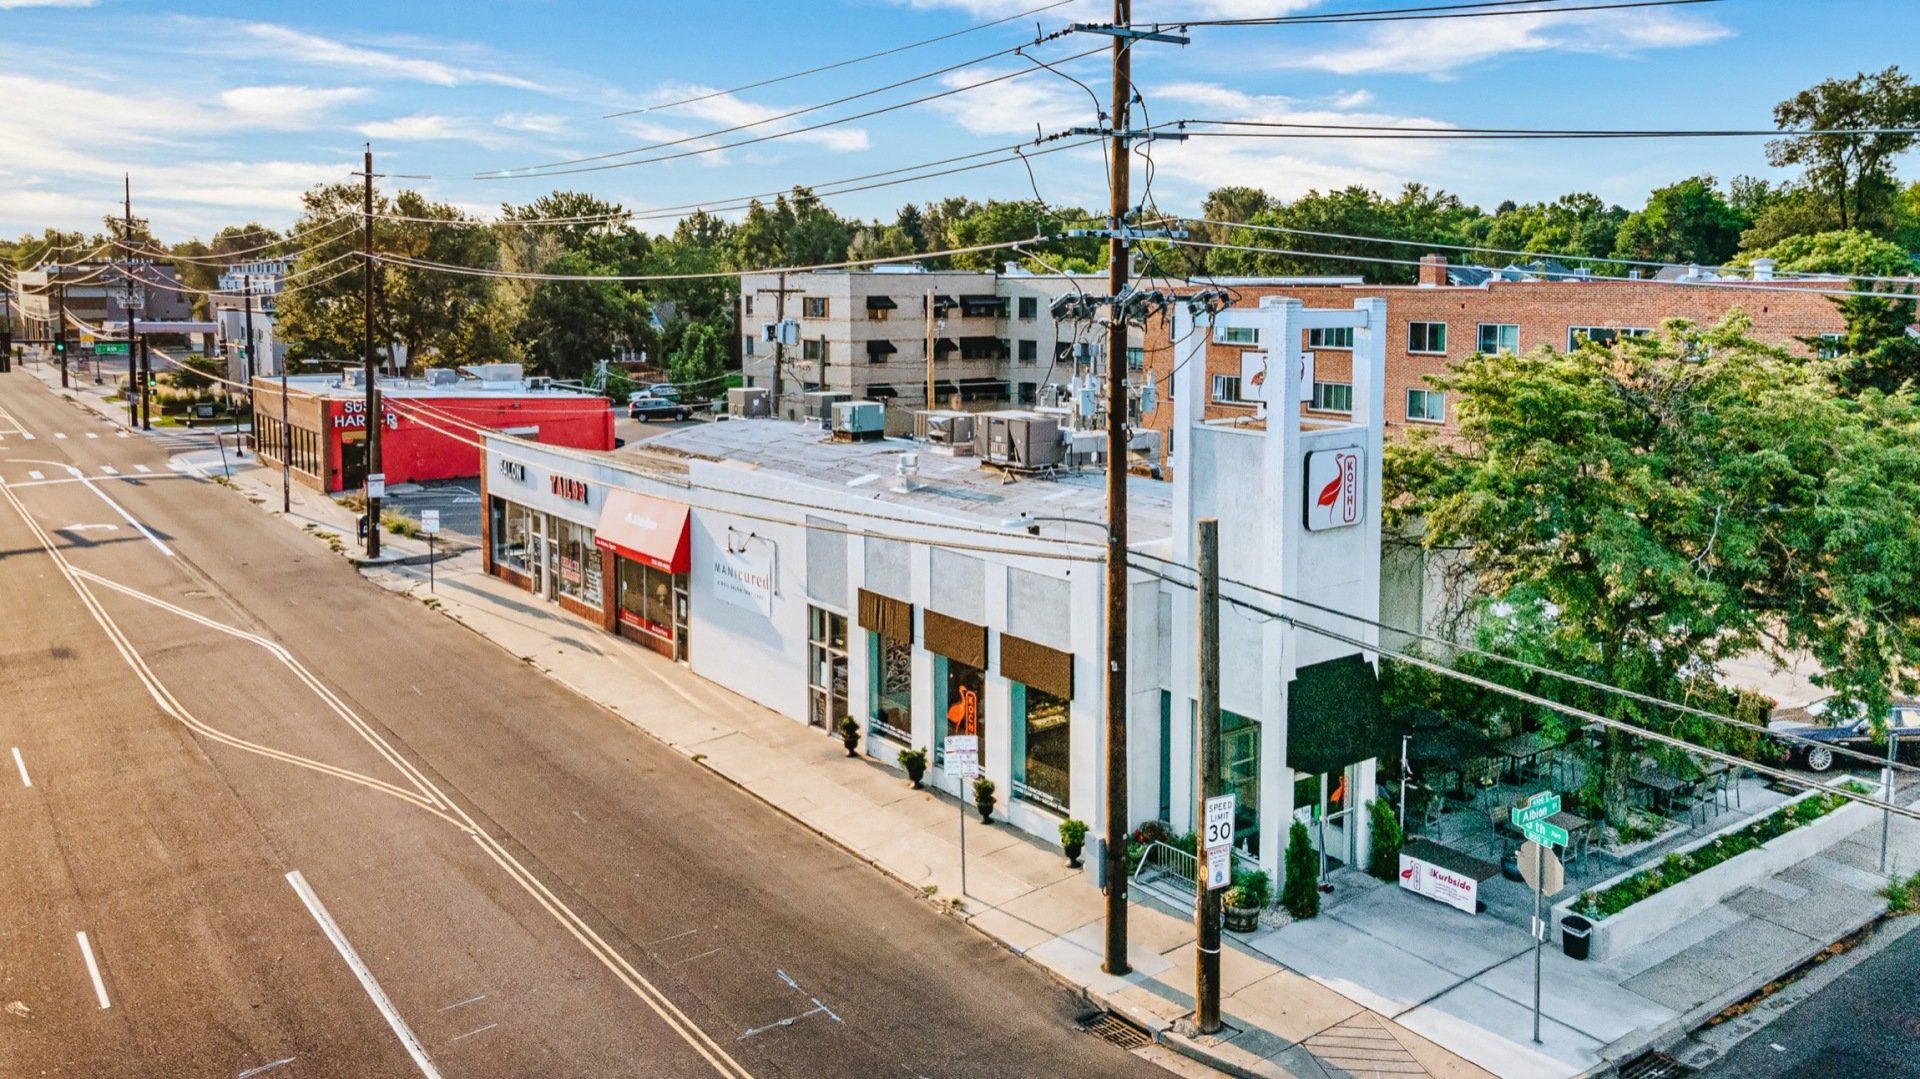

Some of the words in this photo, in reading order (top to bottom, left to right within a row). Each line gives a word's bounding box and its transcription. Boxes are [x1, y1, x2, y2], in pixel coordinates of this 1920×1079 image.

[345, 401, 384, 413] SUI
[335, 414, 397, 427] HARR
[500, 460, 524, 481] SALON
[550, 475, 588, 504] TAILOR
[967, 696, 975, 735] KOCH
[1209, 802, 1232, 813] SPEED
[1522, 806, 1547, 823] Albion
[1211, 812, 1229, 822] LIMIT
[1208, 822, 1231, 842] 30
[1432, 868, 1471, 891] Kurbside
